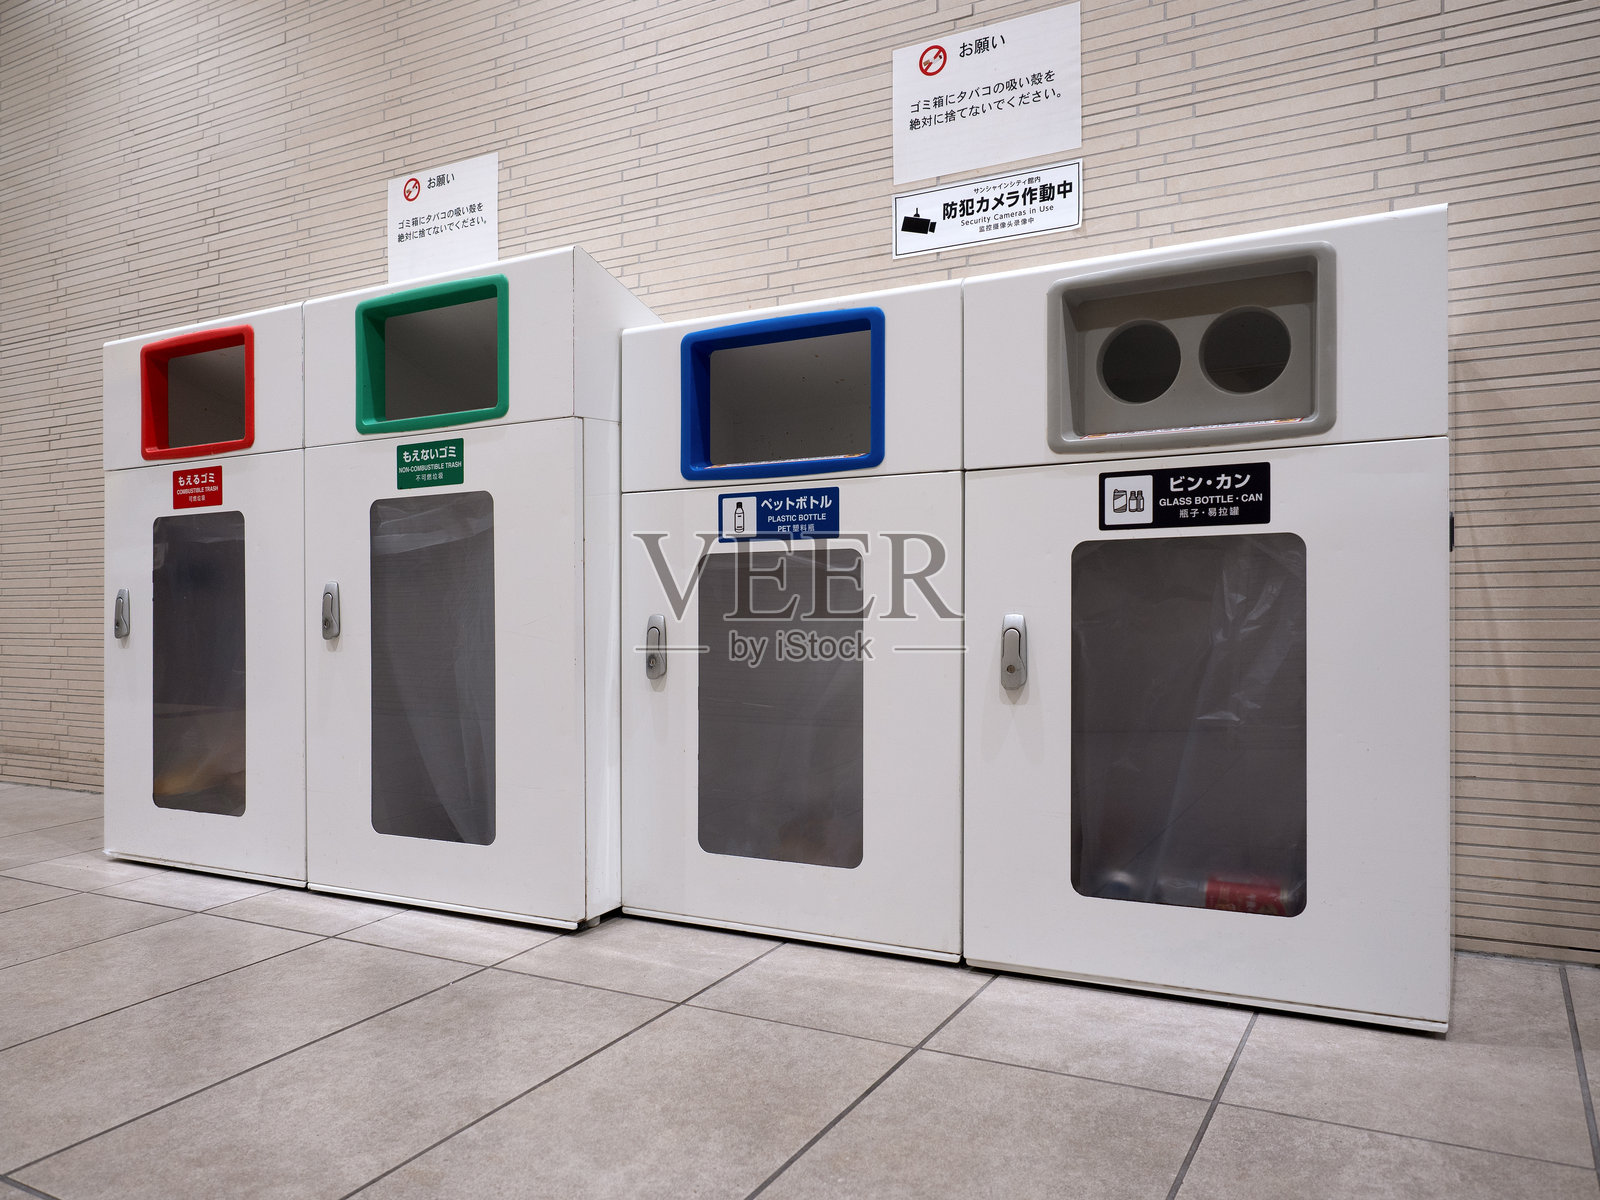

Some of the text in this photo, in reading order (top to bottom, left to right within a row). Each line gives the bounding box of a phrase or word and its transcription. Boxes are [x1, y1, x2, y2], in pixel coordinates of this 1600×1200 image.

[959, 34, 1006, 58] お願い
[910, 69, 1056, 114] ゴミ箱にタバコの吸い殻を
[909, 87, 1063, 131] 絶対に捨てないでください。
[427, 173, 455, 190] お願い
[973, 175, 1042, 195] サンシャインシティ館内
[942, 179, 1073, 221] 防犯カメラ作動中
[398, 202, 484, 230] ゴミ箱にタバコの吸い殻を
[960, 204, 1055, 227] Security Cameras in Use
[397, 216, 487, 243] 絶対に捨てないでください。
[403, 446, 456, 463] もえないゴミ
[399, 461, 462, 474] NON-COMBUSTIBLE TRASH
[178, 473, 215, 486] もえるゴミ
[1169, 473, 1251, 492] ビン・カン
[177, 487, 204, 495] COMBUSTIBLE
[760, 495, 832, 511] ペットボトル
[1158, 497, 1192, 507] GLASS
[767, 513, 827, 523] PLASTIC BOTTLE
